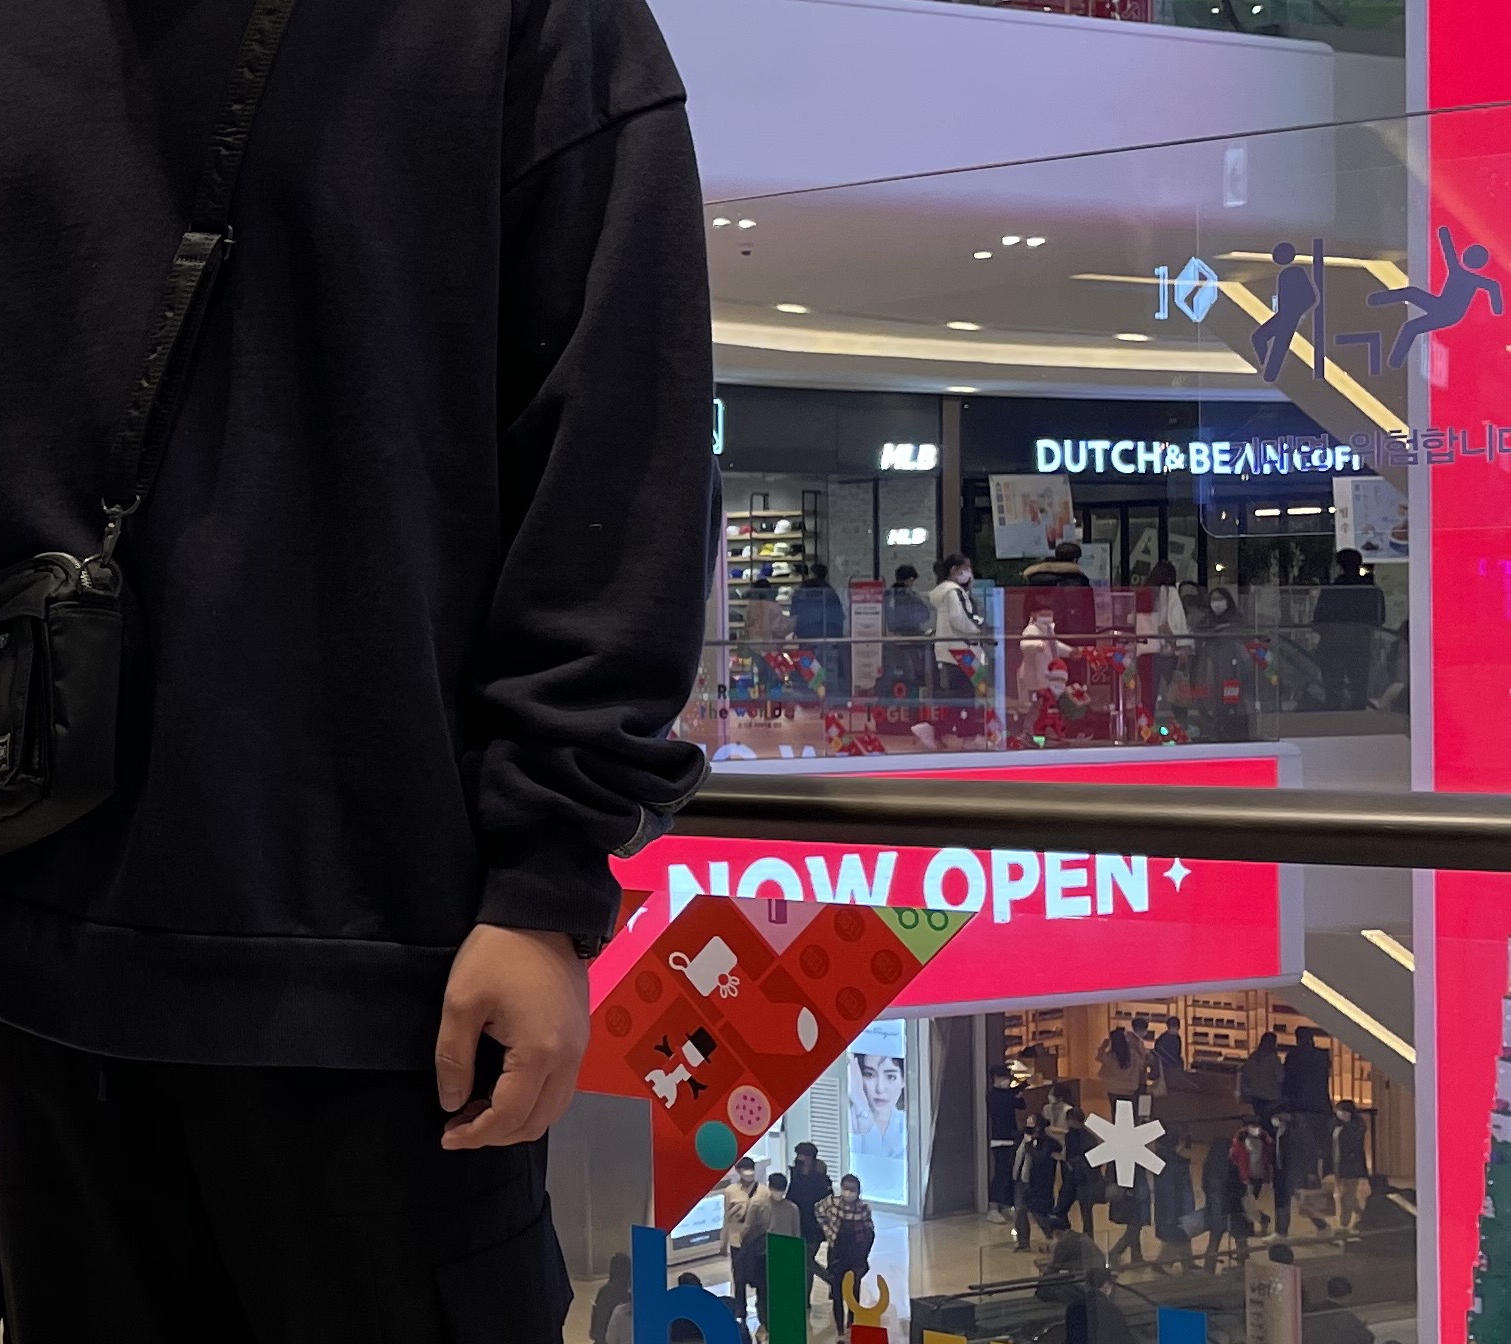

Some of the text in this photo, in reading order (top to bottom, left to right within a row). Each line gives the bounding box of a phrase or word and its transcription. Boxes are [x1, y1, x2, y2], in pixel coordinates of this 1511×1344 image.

[880, 442, 939, 471] MLB
[886, 527, 929, 546] MLB
[666, 846, 1150, 924] NOW OPEN
